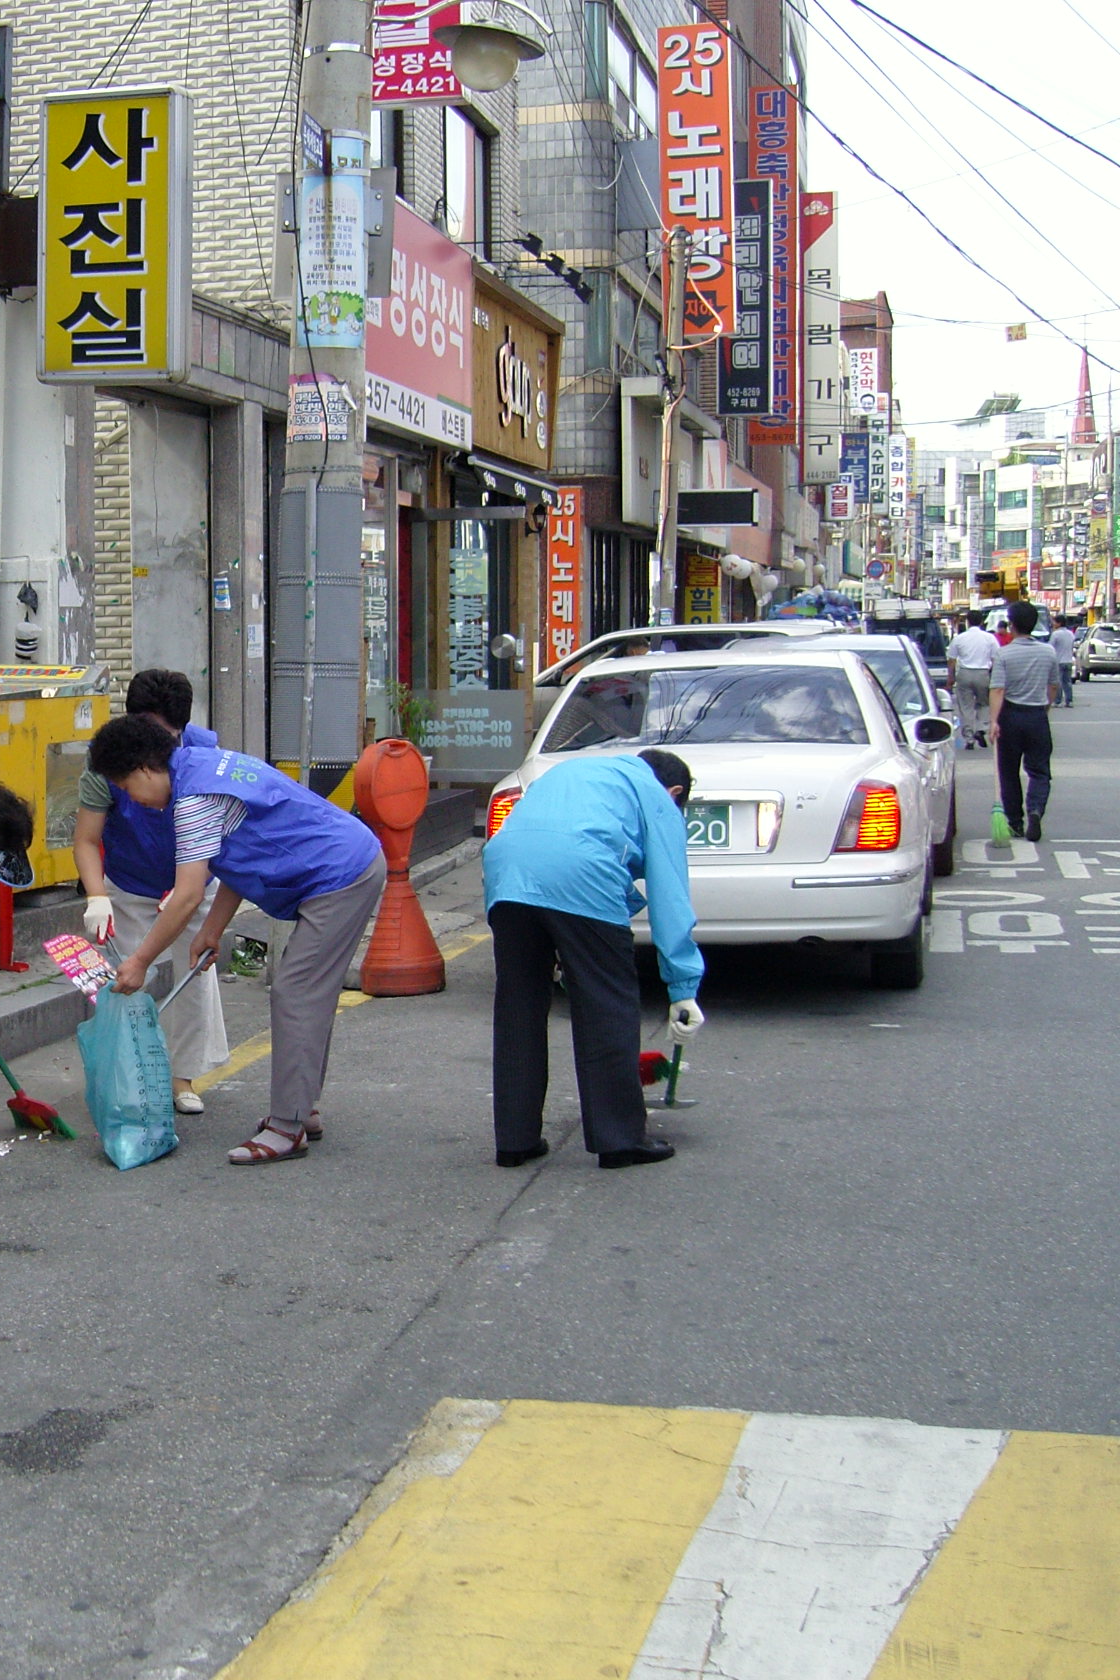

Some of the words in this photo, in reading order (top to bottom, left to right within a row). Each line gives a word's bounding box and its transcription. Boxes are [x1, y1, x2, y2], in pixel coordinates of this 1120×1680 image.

[58, 107, 158, 365] 사진실
[366, 379, 426, 428] 457-4421
[860, 352, 874, 390] 현수막
[552, 553, 575, 661] 노래방
